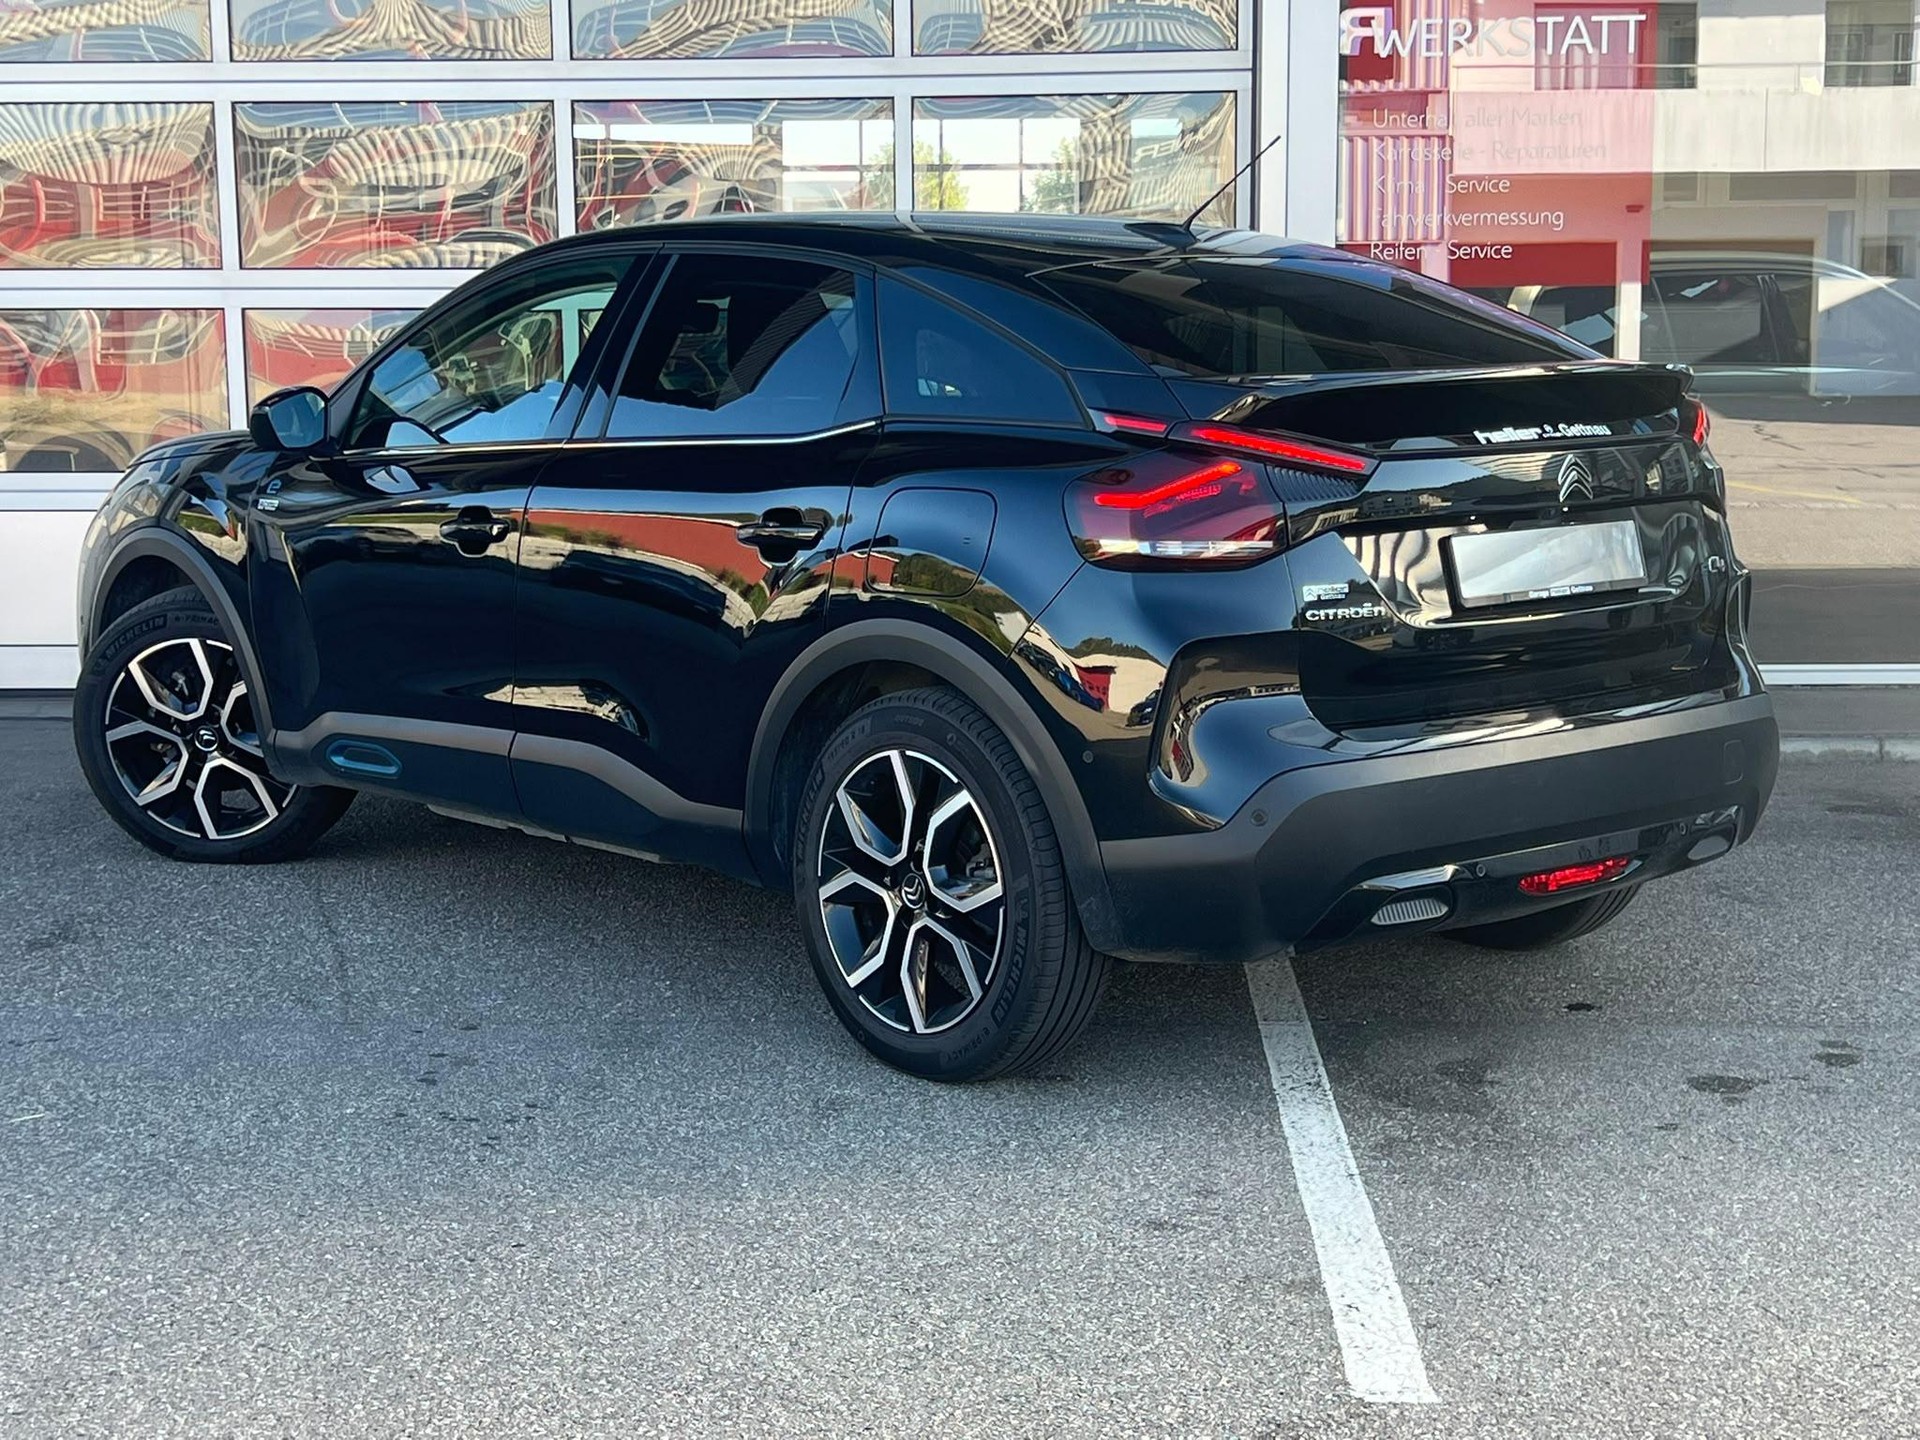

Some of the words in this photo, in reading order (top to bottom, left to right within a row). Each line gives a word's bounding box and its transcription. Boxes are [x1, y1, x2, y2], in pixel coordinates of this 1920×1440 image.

[1371, 14, 1647, 58] WERKSTATT
[1446, 174, 1511, 194] Service
[1370, 236, 1427, 260] Reifen
[1447, 240, 1513, 260] Service
[1557, 423, 1613, 437] Gettnau
[105, 616, 165, 659] MICHELIN
[994, 925, 1028, 1027] MICHELIN
